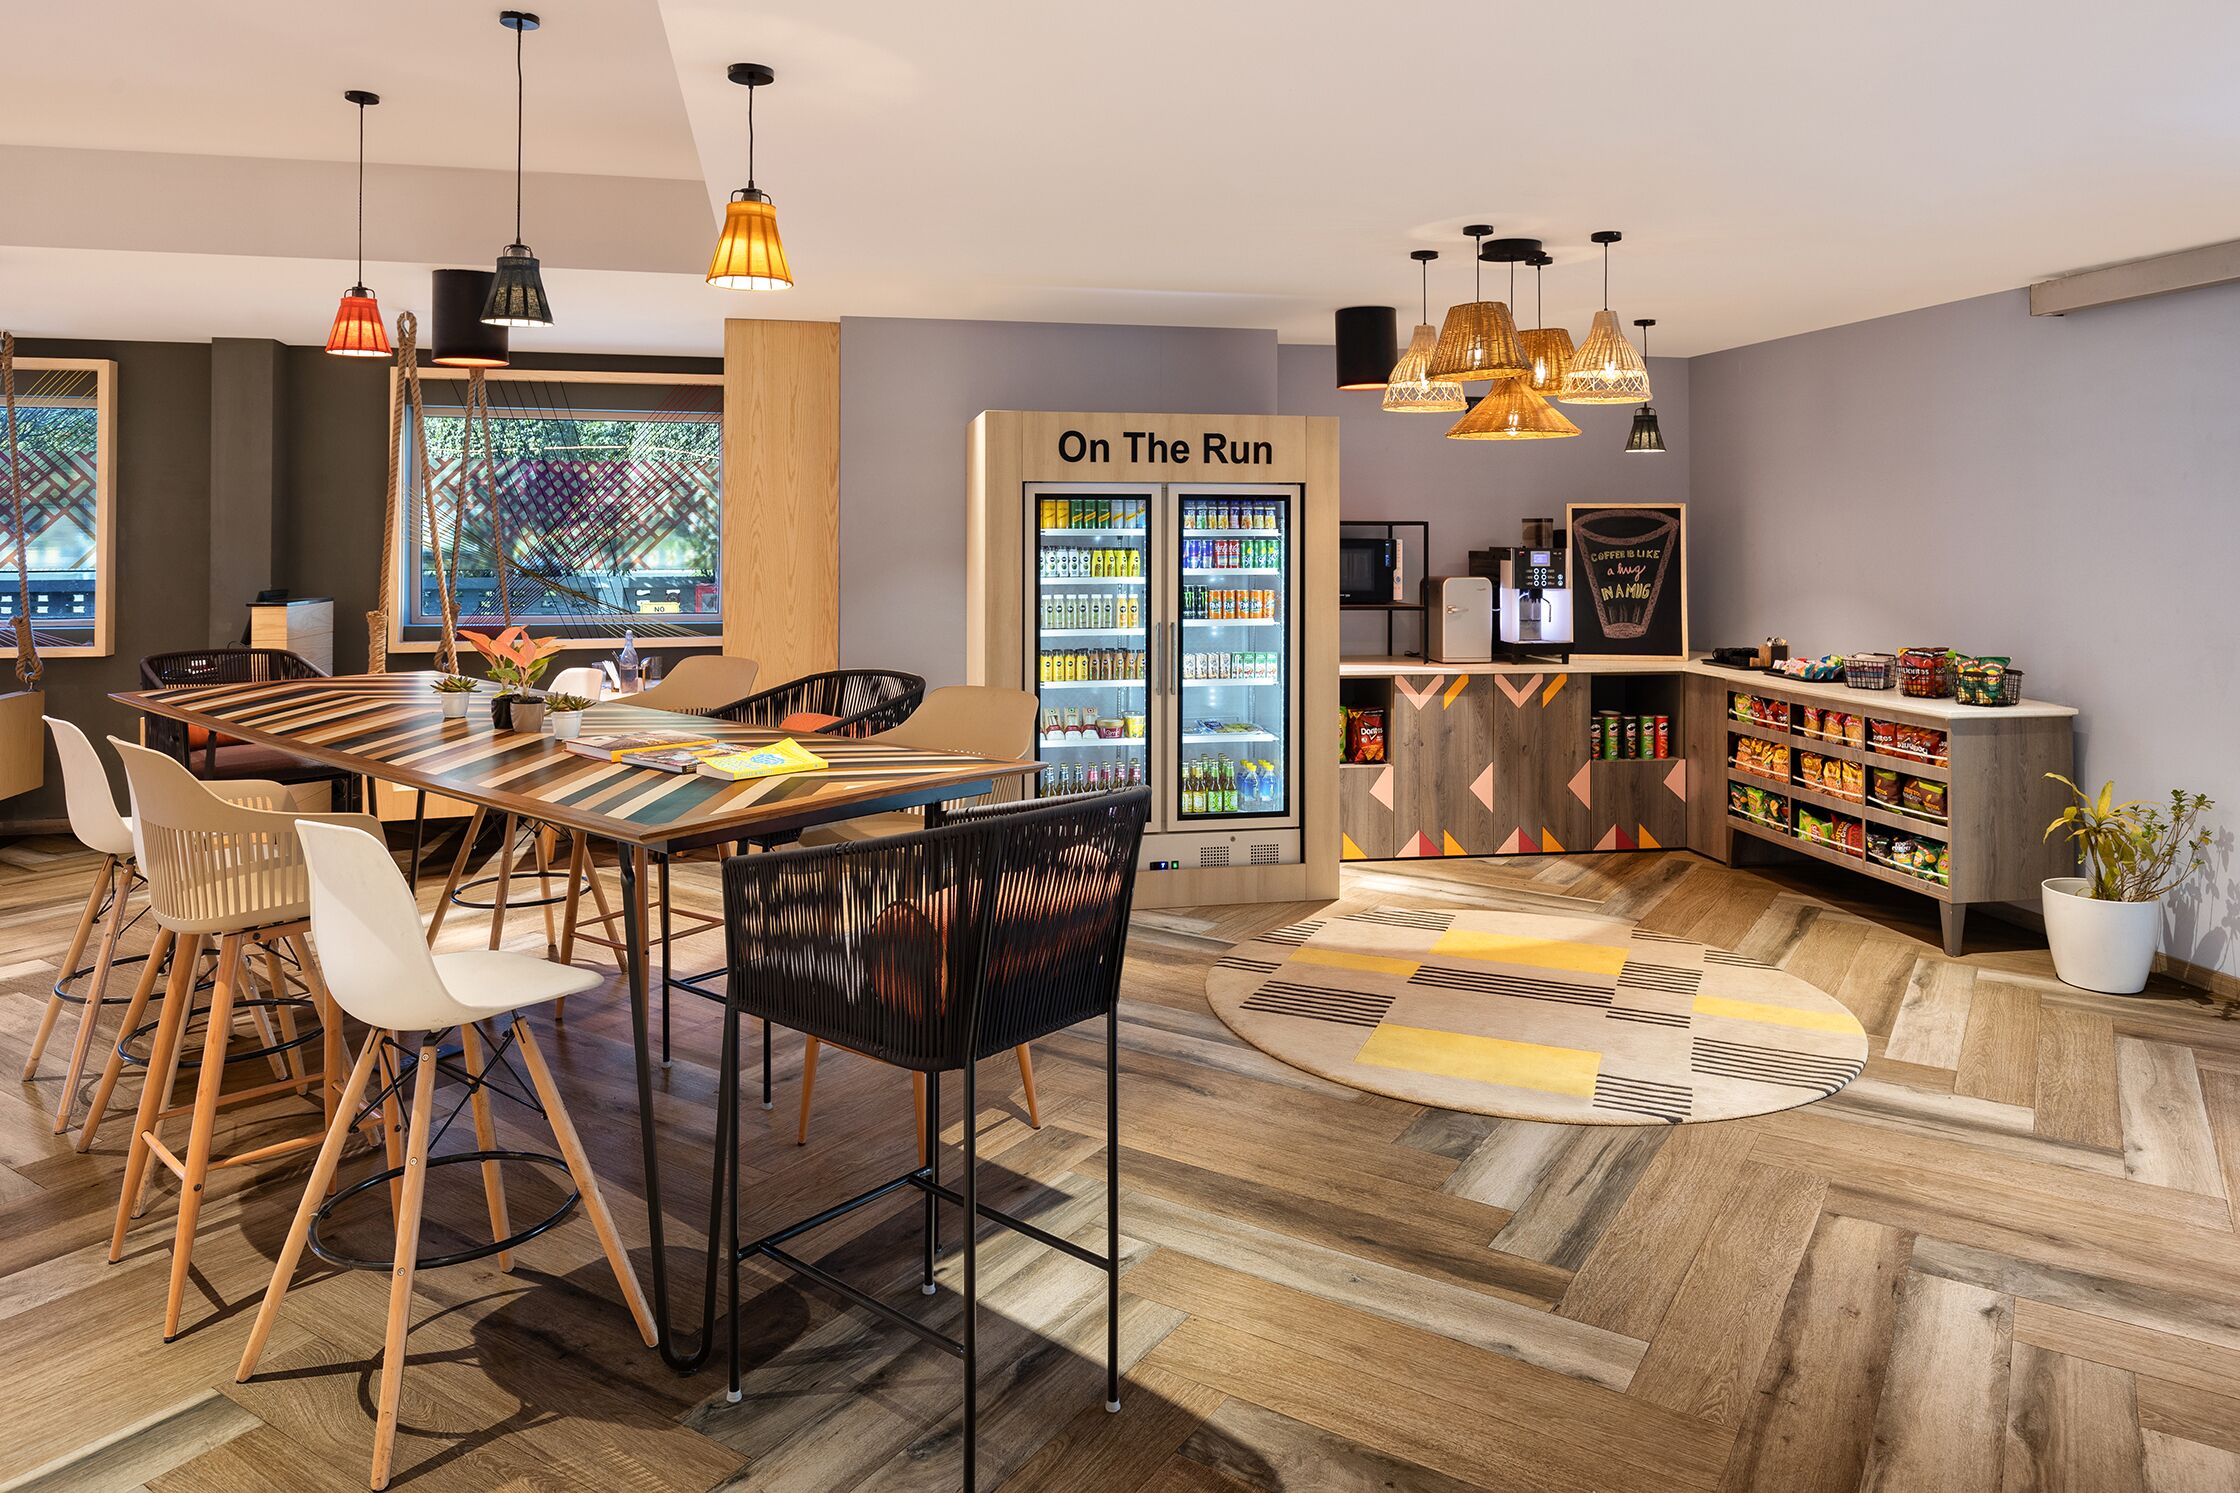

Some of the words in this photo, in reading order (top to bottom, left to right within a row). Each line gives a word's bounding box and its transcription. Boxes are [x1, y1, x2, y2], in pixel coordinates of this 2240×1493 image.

[1058, 430, 1110, 463] On
[1123, 431, 1190, 463] The
[1203, 432, 1273, 465] Run
[1591, 550, 1625, 562] COFFEE
[1637, 549, 1661, 559] LIKE
[1607, 567, 1615, 576] a
[1617, 562, 1647, 582] hug
[1601, 585, 1614, 601] IN
[1615, 583, 1625, 599] A
[1625, 583, 1651, 599] MUG
